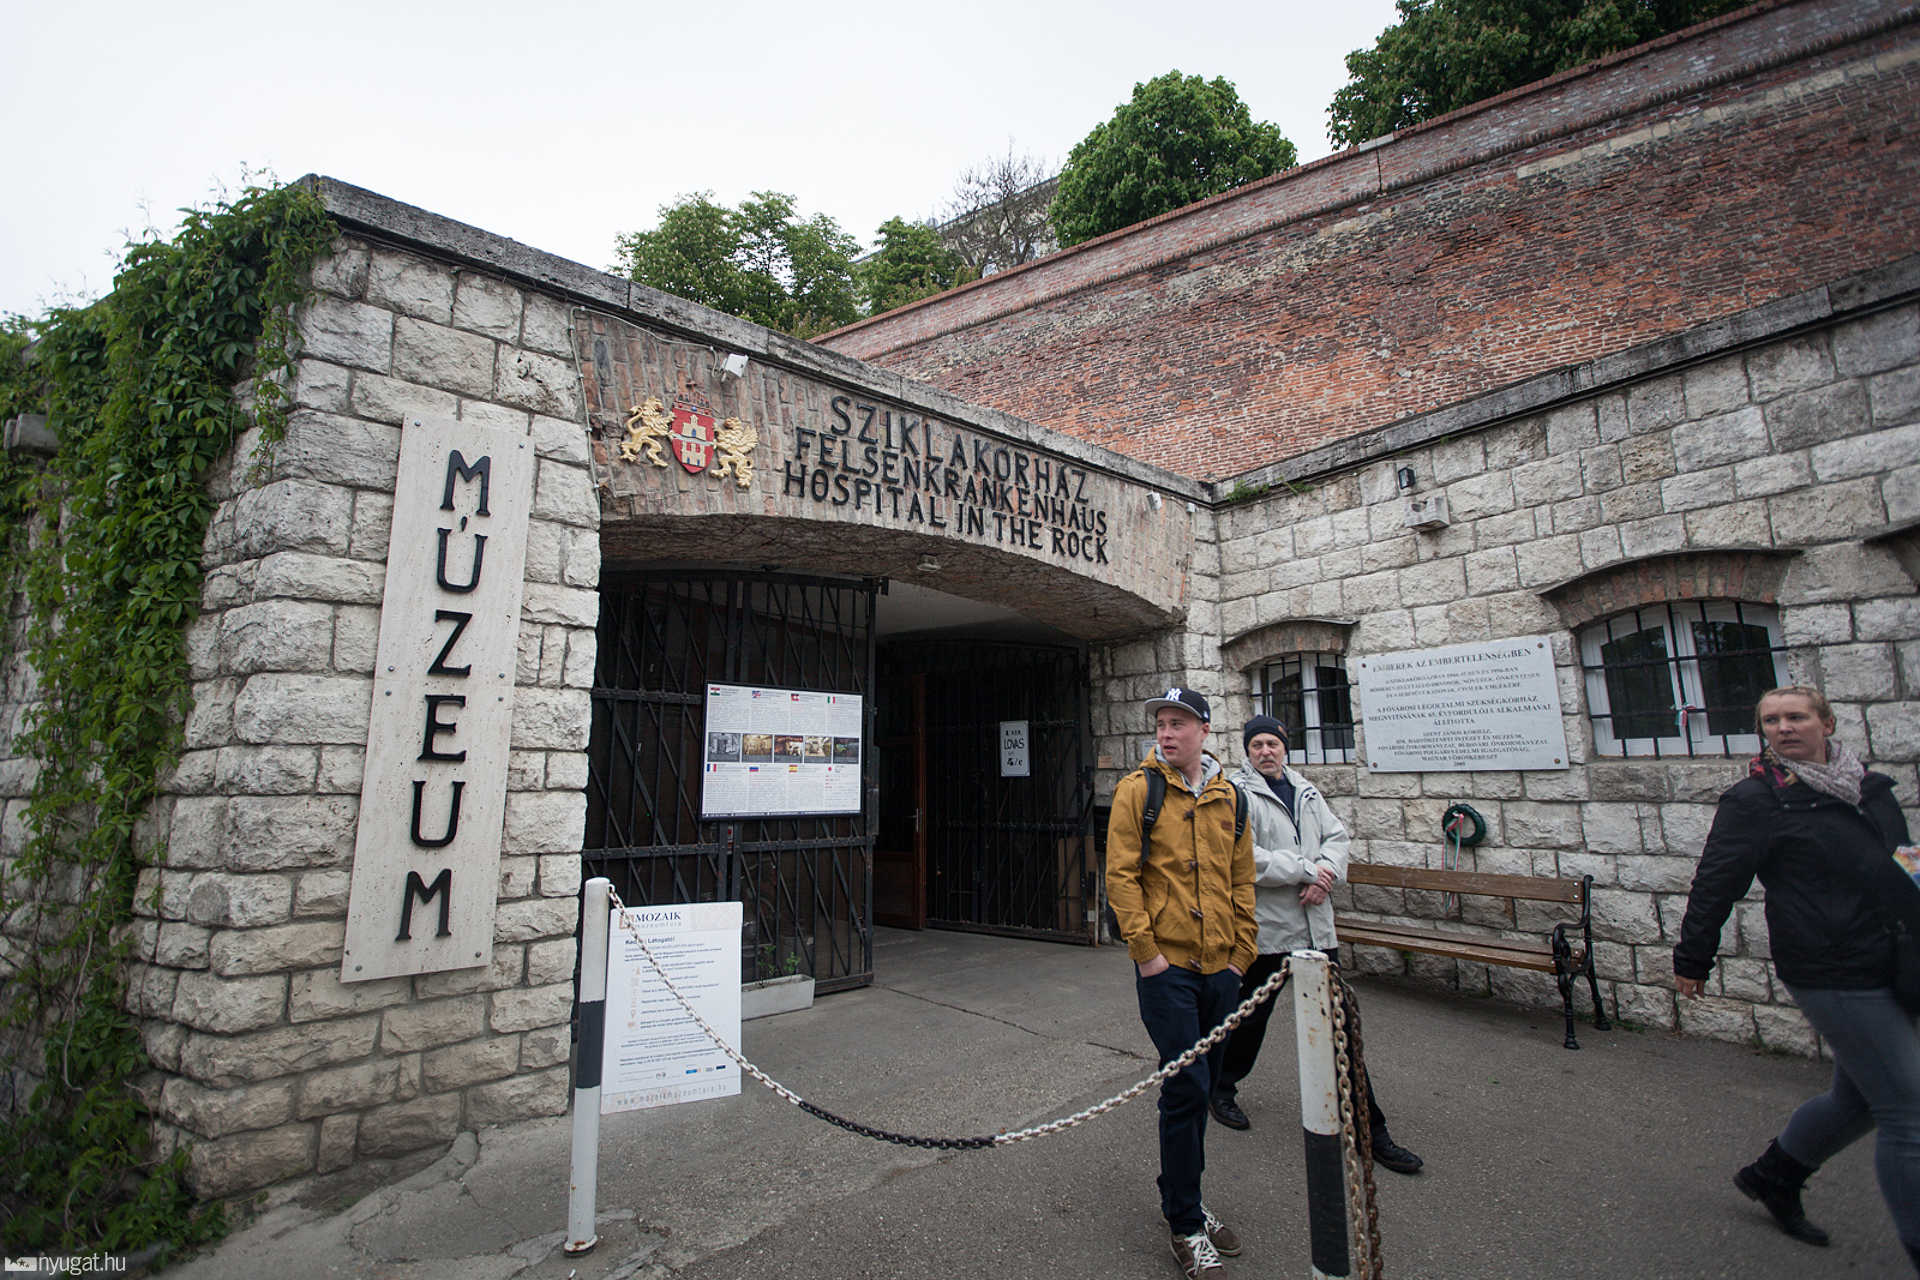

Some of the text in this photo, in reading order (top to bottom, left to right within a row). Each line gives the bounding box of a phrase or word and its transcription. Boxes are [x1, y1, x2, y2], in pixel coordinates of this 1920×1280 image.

[784, 458, 1108, 565] HOSPITAL IN THE ROCK
[795, 426, 1107, 536] FELSENKRANKENHAUS
[396, 449, 492, 942] MÚZEUM
[635, 911, 682, 922] MOZAIK
